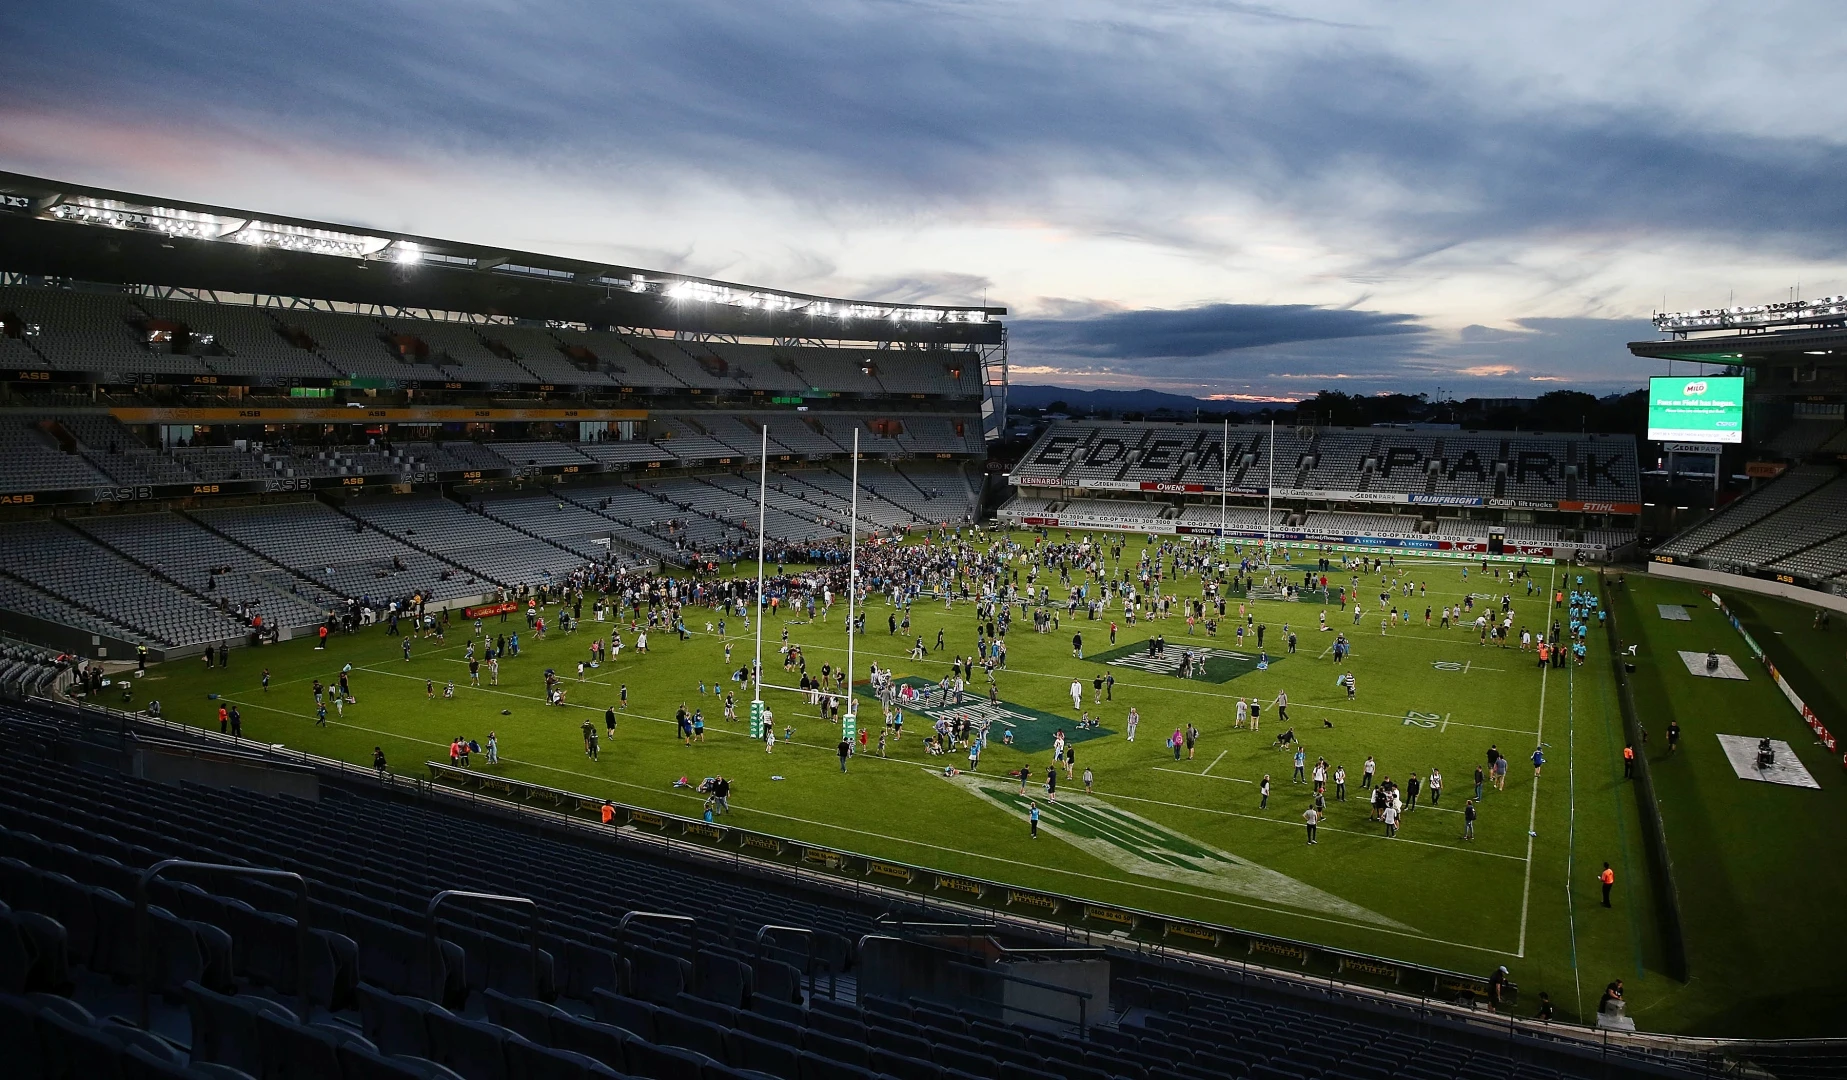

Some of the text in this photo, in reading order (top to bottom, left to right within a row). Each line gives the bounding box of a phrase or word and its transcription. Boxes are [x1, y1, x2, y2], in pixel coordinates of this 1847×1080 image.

[19, 371, 50, 380] ASB
[104, 371, 156, 385] ASB
[194, 376, 218, 384] ASB
[332, 379, 351, 387] ASB
[1035, 436, 1245, 472] EDEN
[1382, 447, 1623, 487] PARK
[464, 471, 482, 479] ASB
[265, 478, 312, 493] ASB
[1022, 477, 1060, 485] KENNARDS
[193, 485, 220, 493] ASB
[1157, 483, 1185, 491] OWENS
[94, 486, 153, 501] ASB
[0, 494, 35, 504] ASB
[1413, 495, 1478, 505] MAINFREIGHT
[1582, 502, 1616, 511] STIHL
[1655, 555, 1673, 563] ASB
[1708, 560, 1743, 576] ASB
[1777, 574, 1794, 584] ASB
[1403, 710, 1441, 728] 22
[884, 867, 907, 876] GROUP
[1016, 896, 1052, 907] TRAILERS
[1091, 908, 1105, 916] 0800
[1184, 927, 1213, 938] GROUP
[1259, 945, 1300, 958] TRAILERS
[1350, 963, 1393, 976] TRAILERS
